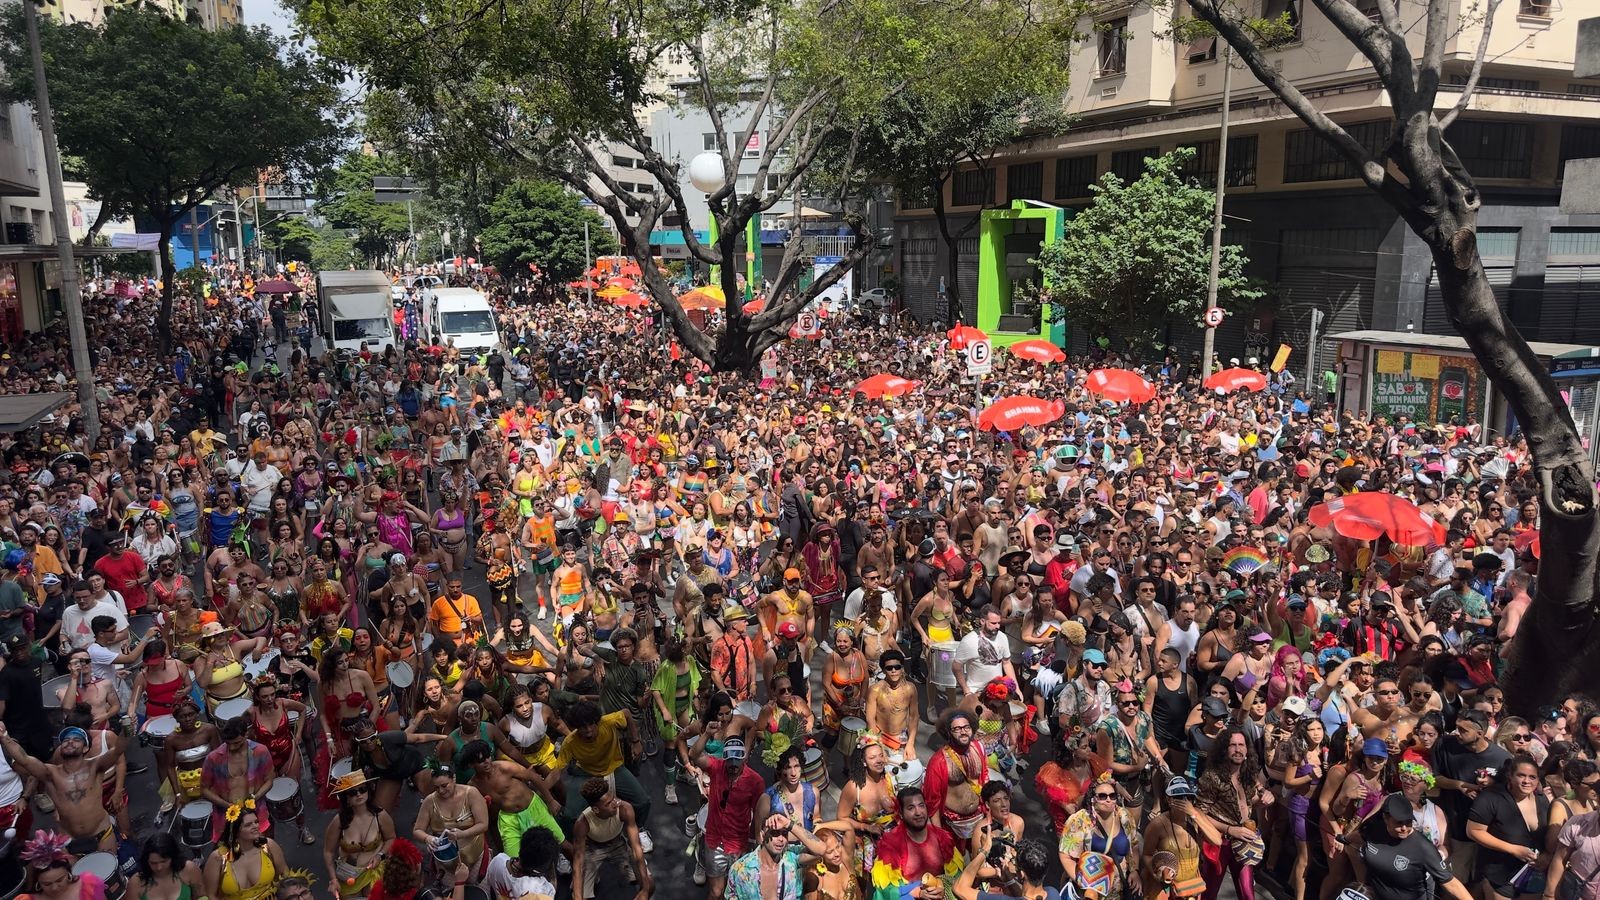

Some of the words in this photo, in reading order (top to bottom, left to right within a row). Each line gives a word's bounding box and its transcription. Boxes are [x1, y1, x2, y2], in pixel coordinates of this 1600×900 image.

[976, 344, 984, 360] E
[1376, 395, 1389, 404] QUE
[1389, 395, 1403, 404] NEM
[1403, 395, 1427, 404] PARECE
[1004, 405, 1042, 419] BRAHMA
[1388, 404, 1416, 415] ZERO
